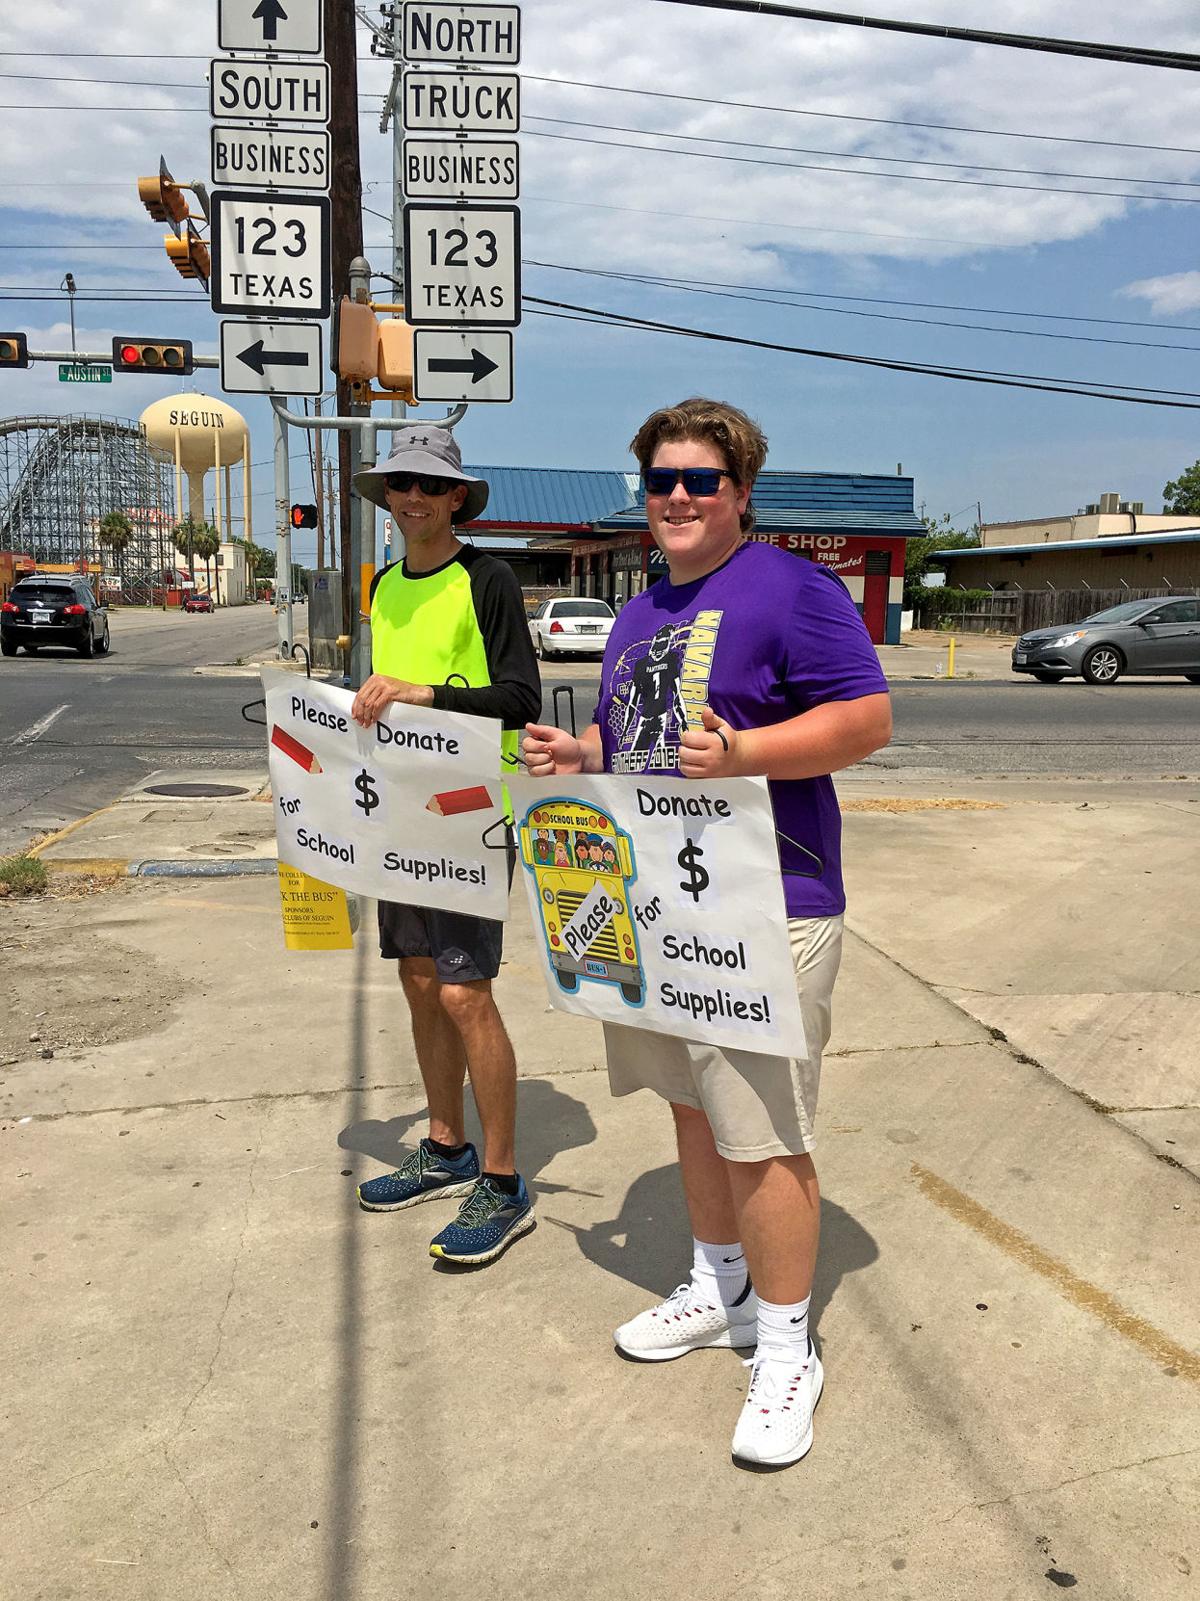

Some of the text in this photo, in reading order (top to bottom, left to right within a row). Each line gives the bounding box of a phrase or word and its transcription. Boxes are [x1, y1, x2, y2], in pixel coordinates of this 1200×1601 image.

[412, 12, 512, 53] NORTH
[220, 70, 320, 112] SOUTH
[410, 85, 513, 119] TRUCK
[216, 142, 324, 175] BUSINESS
[409, 155, 514, 184] BUSINESS
[235, 217, 307, 257] 123
[428, 229, 497, 267] 123
[230, 274, 313, 299] TEXAS
[423, 285, 503, 307] TEXAS
[67, 367, 101, 382] AUSTIN
[169, 410, 225, 429] SEGUIN
[787, 535, 847, 549] SHOP
[817, 553, 840, 561] FREE
[820, 556, 863, 570] timates
[652, 672, 661, 700] 1
[291, 696, 460, 755] Please Donate
[280, 796, 301, 817] for
[354, 768, 379, 816] $
[636, 788, 732, 818] Donate
[549, 814, 589, 826] SCHOOL BUS
[297, 828, 486, 885] School Supplies!
[677, 838, 709, 902] $
[290, 892, 310, 902] THE
[566, 894, 614, 956] Please
[634, 895, 661, 931] for
[662, 935, 746, 970] School
[586, 963, 607, 974] BUS-1
[660, 983, 771, 1024] Supplies!
